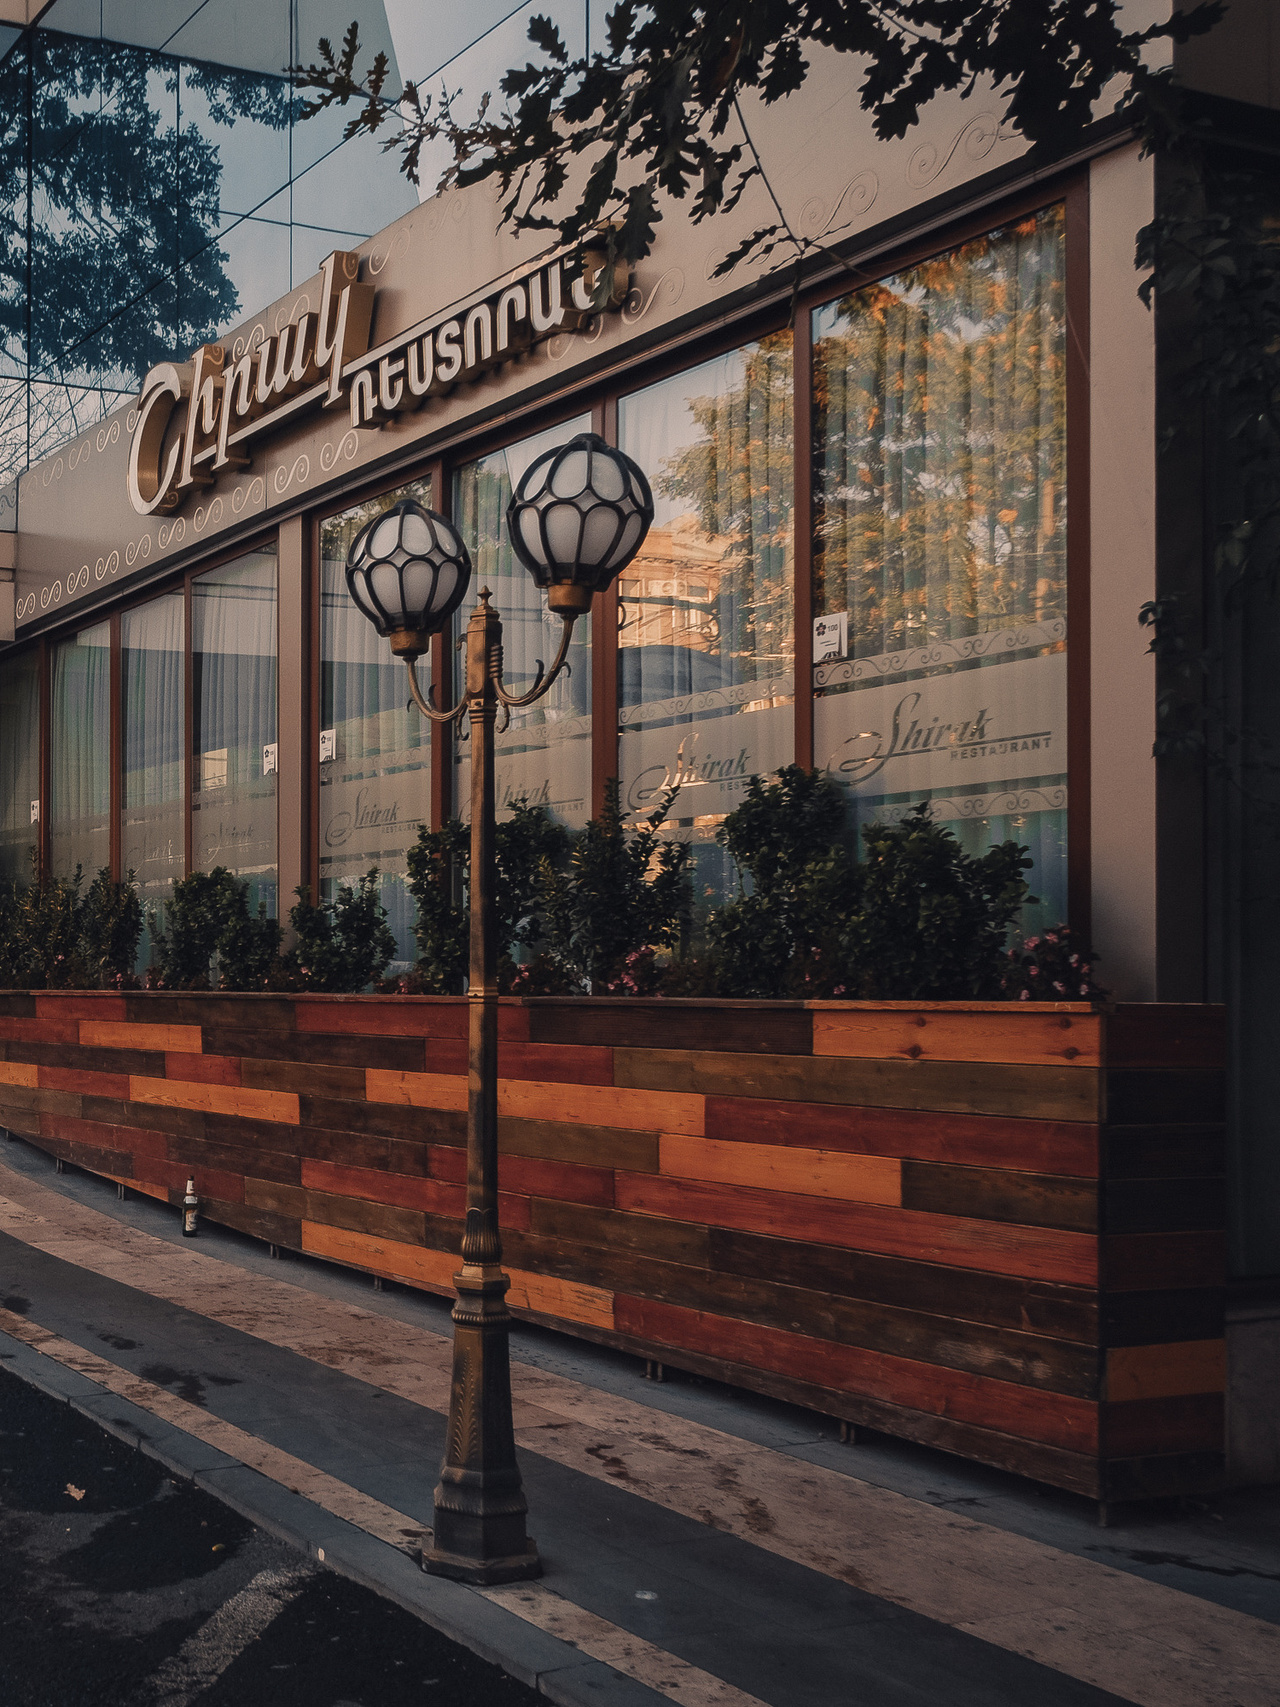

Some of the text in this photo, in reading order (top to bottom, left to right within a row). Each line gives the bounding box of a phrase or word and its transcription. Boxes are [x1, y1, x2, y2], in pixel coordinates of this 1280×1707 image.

[628, 732, 751, 813] Shirak
[826, 692, 992, 787] Shirak
[950, 737, 1052, 761] RESTAURANT
